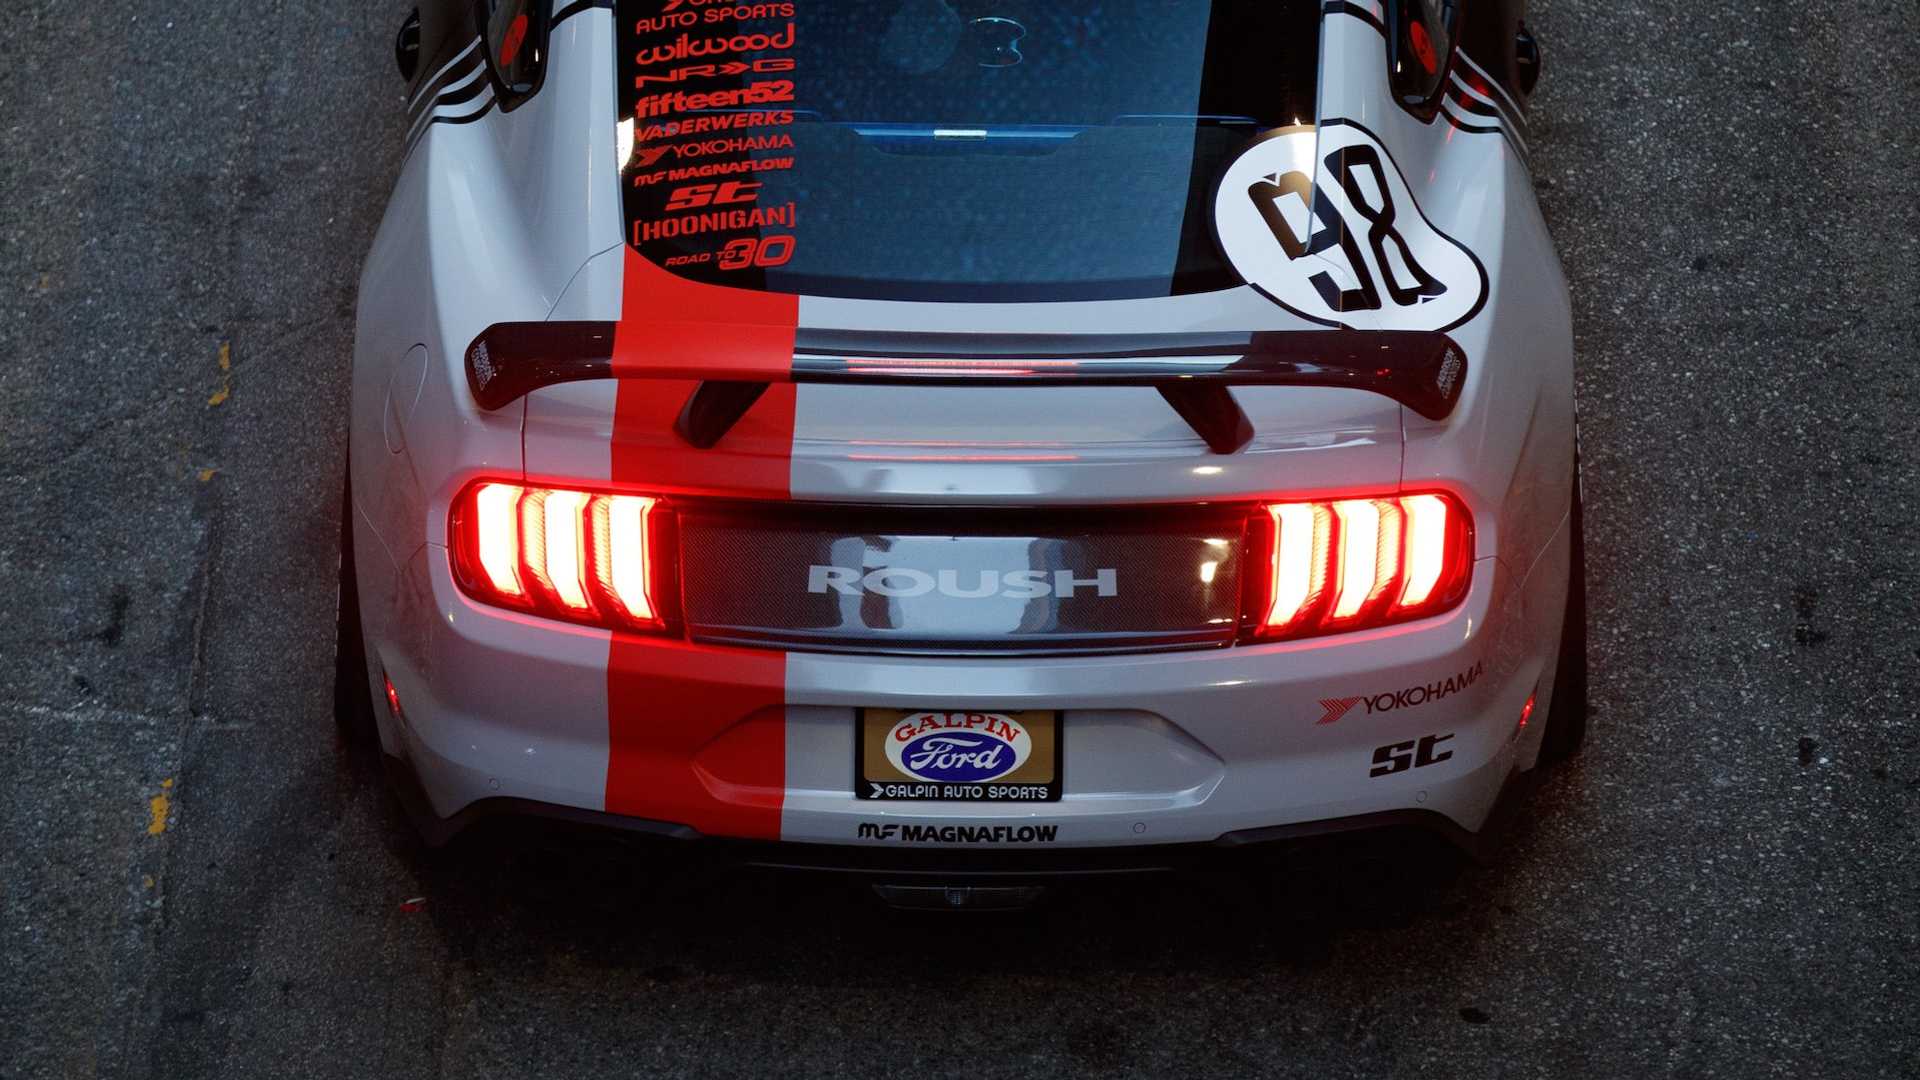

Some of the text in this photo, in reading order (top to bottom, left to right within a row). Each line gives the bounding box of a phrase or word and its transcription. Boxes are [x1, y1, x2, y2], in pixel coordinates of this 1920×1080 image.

[636, 3, 794, 34] AUTO SPORTS
[635, 22, 795, 65] wilwood
[635, 80, 794, 118] fifteen52
[635, 110, 794, 142] VADERWERKS
[673, 134, 793, 158] YOKOHAMA
[668, 157, 794, 182] MAGNAFLOW
[1248, 144, 1447, 312] 98
[665, 253, 711, 267] ROAD
[808, 565, 1117, 598] ROUSH
[1363, 660, 1483, 714] YOKOHAMA
[895, 711, 1020, 742] GALPIN
[910, 737, 1003, 770] Ford
[885, 785, 1048, 799] GALPIN AUTO SPORTS
[901, 825, 1058, 842] MAGNAFLOW
